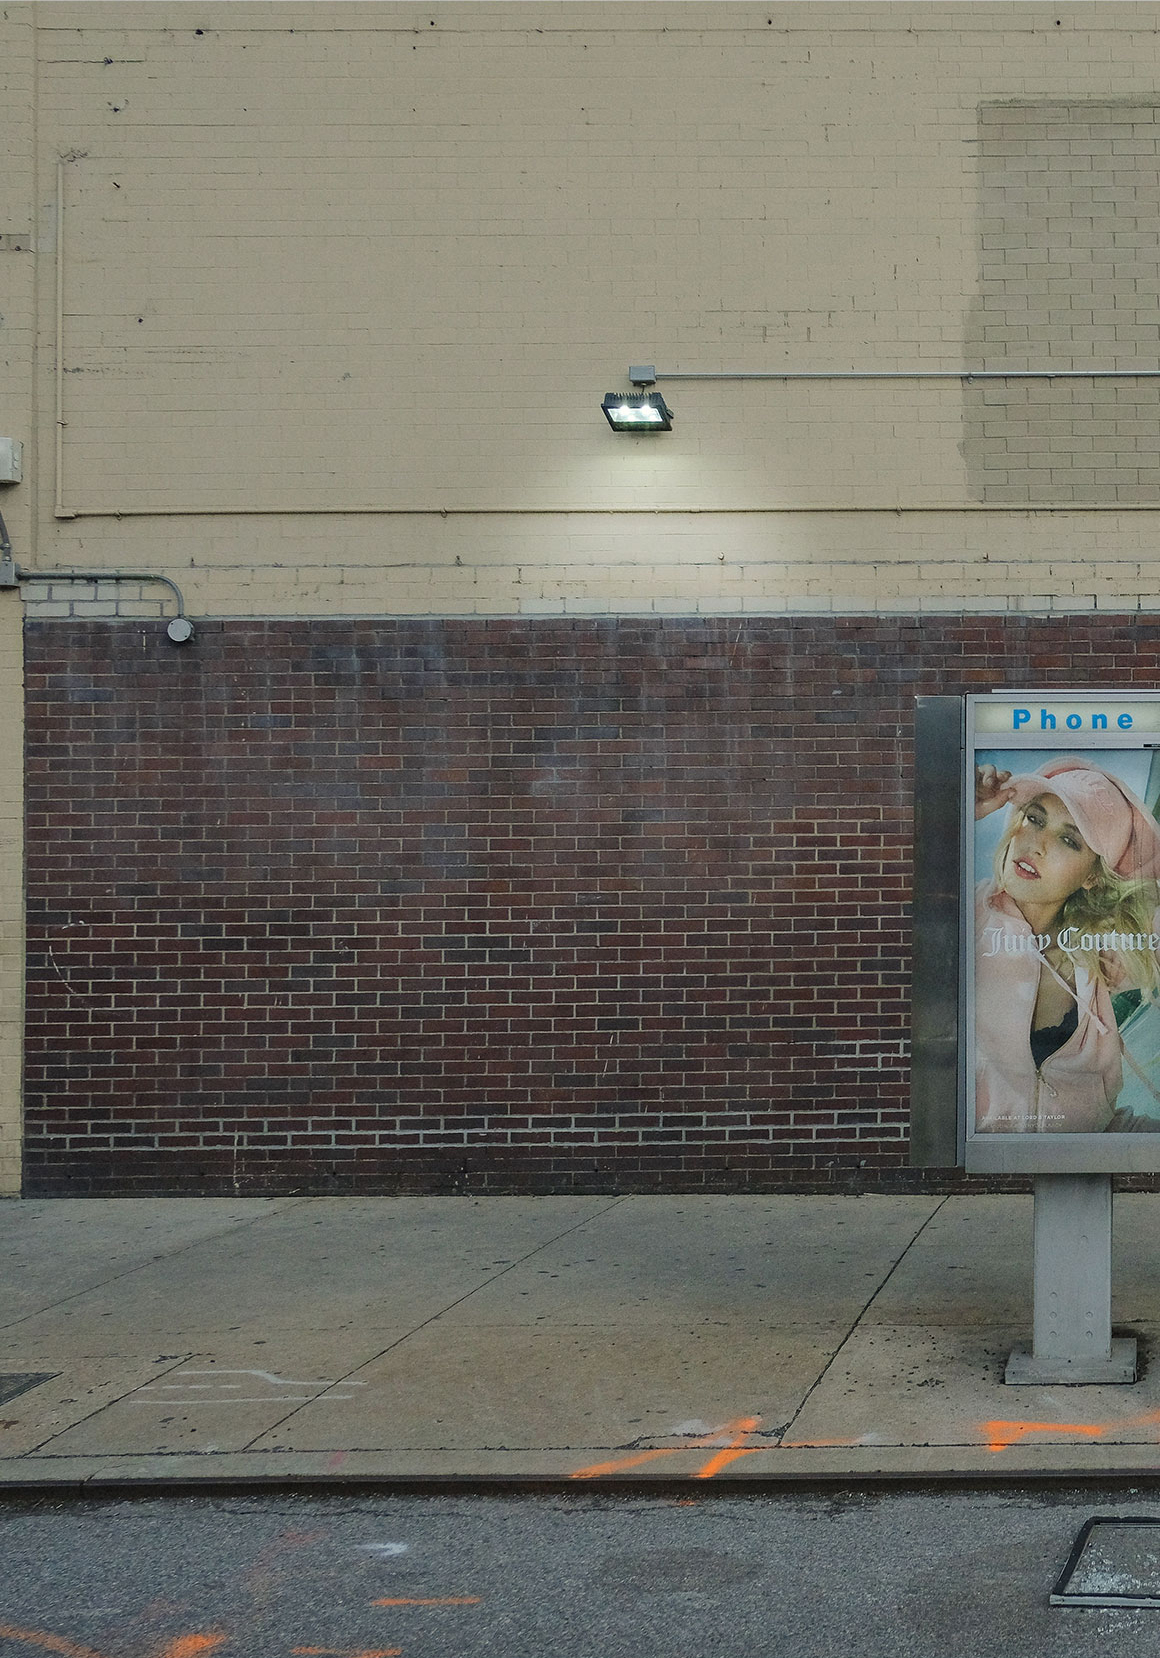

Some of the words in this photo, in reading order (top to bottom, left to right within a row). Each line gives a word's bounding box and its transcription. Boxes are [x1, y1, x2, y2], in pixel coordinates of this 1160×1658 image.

[1013, 709, 1133, 730] Phone
[982, 926, 1051, 958] Juicy
[1056, 926, 1160, 953] Couture
